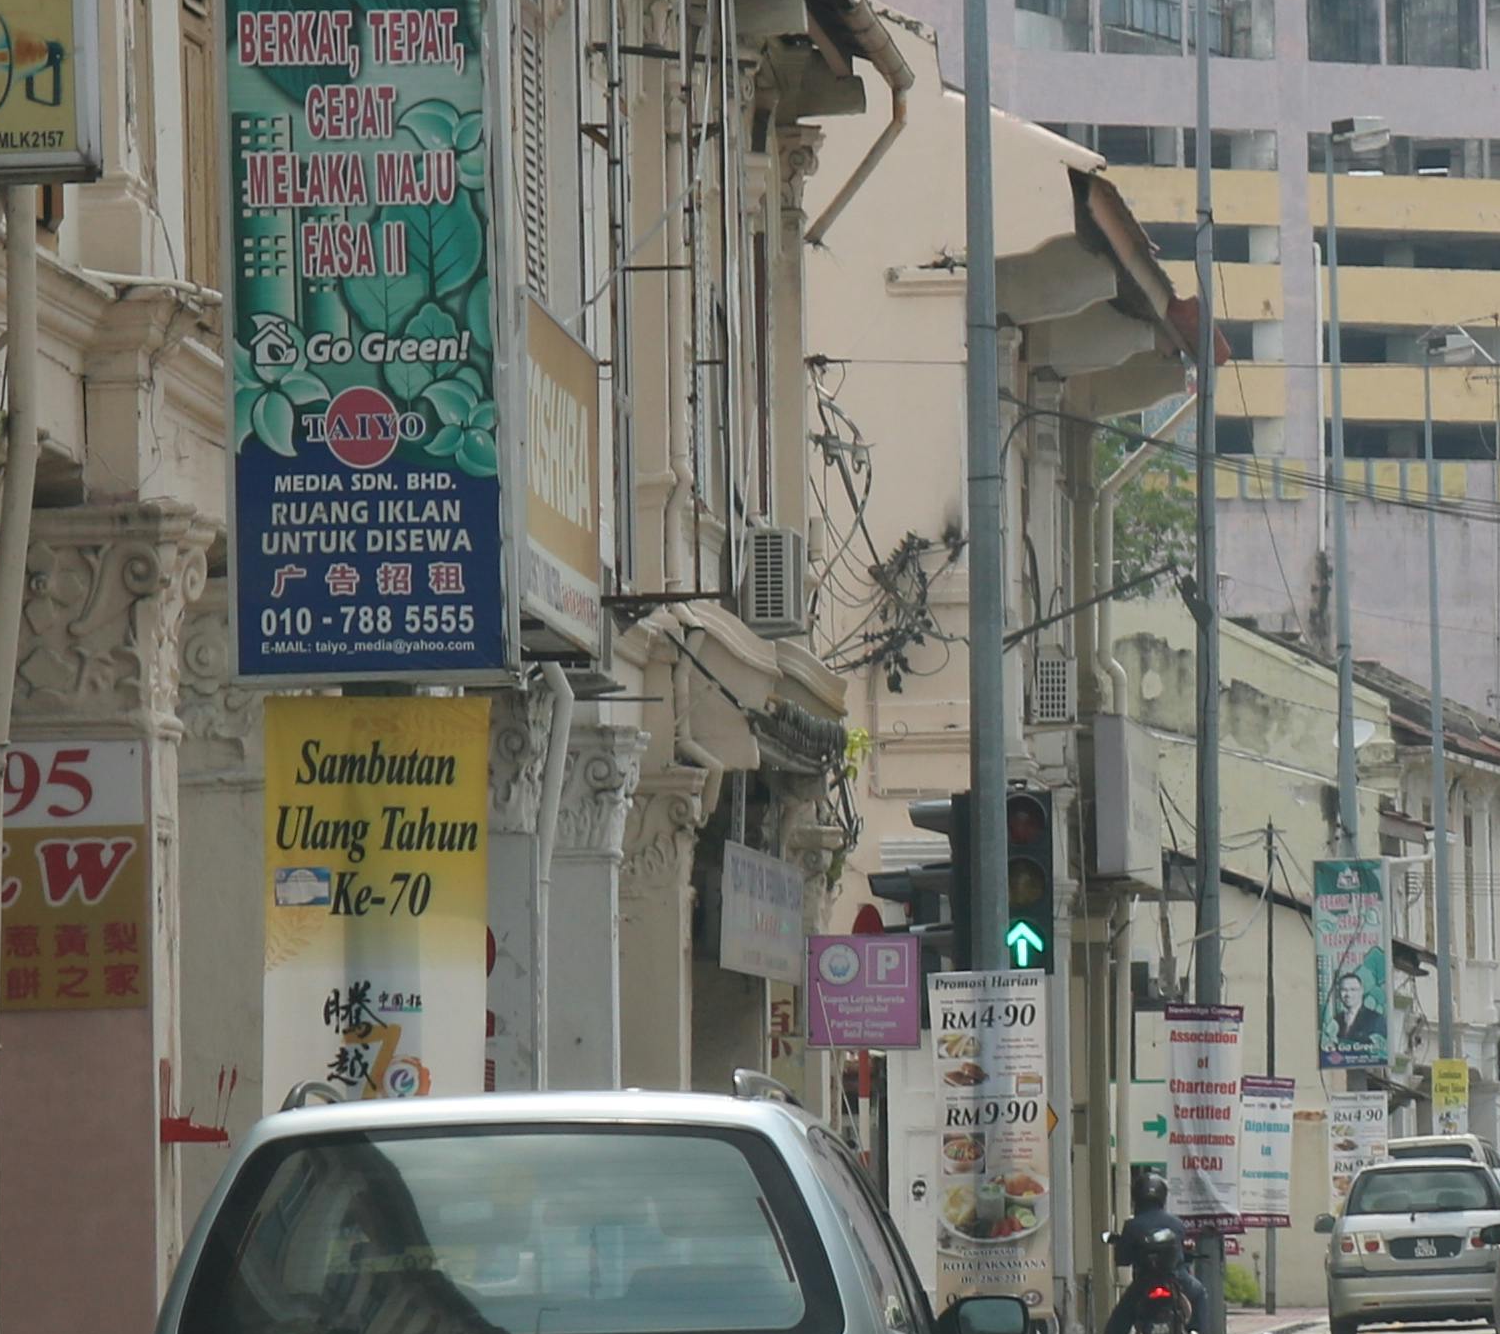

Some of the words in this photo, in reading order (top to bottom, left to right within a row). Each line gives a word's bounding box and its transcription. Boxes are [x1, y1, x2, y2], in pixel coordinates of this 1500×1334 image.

[238, 12, 359, 77] BERKAT,
[367, 9, 464, 75] TEPAT,
[305, 85, 396, 139] CEPAT
[248, 152, 367, 207] MELAKA
[375, 149, 456, 205] MAJU
[302, 222, 375, 276] FASA
[384, 221, 406, 276] II
[306, 332, 352, 363] Go
[360, 330, 471, 363] Green!
[302, 411, 426, 442] TAIYO
[274, 474, 343, 493] MEDIA
[351, 473, 398, 492] SDN.
[407, 472, 456, 490] BHD.
[271, 501, 368, 526] RUANG
[378, 499, 461, 523] IKLAN
[261, 530, 357, 555] UNTUK
[366, 529, 472, 552] DISEWA
[271, 562, 465, 598] 广告招租
[261, 607, 312, 636] 010
[340, 605, 392, 634] 788
[405, 605, 474, 634] 5555
[261, 641, 311, 654] E-MAIL:
[316, 638, 475, 655] taiyo_media@yahoo.com
[296, 740, 456, 787] Sambutan
[3, 749, 92, 817] 95
[276, 805, 370, 862] Ulang
[380, 806, 478, 852] Tahun
[330, 873, 431, 917] Ke-70
[877, 949, 900, 981] P
[935, 977, 987, 992] Promosi
[991, 975, 1038, 989] Harian
[1169, 1030, 1238, 1044] Association
[1197, 1055, 1209, 1068] of
[1169, 1079, 1236, 1095] Chartered
[1174, 1105, 1231, 1120] Certified
[1244, 1120, 1290, 1134] Diploma
[1169, 1132, 1235, 1146] Accountants
